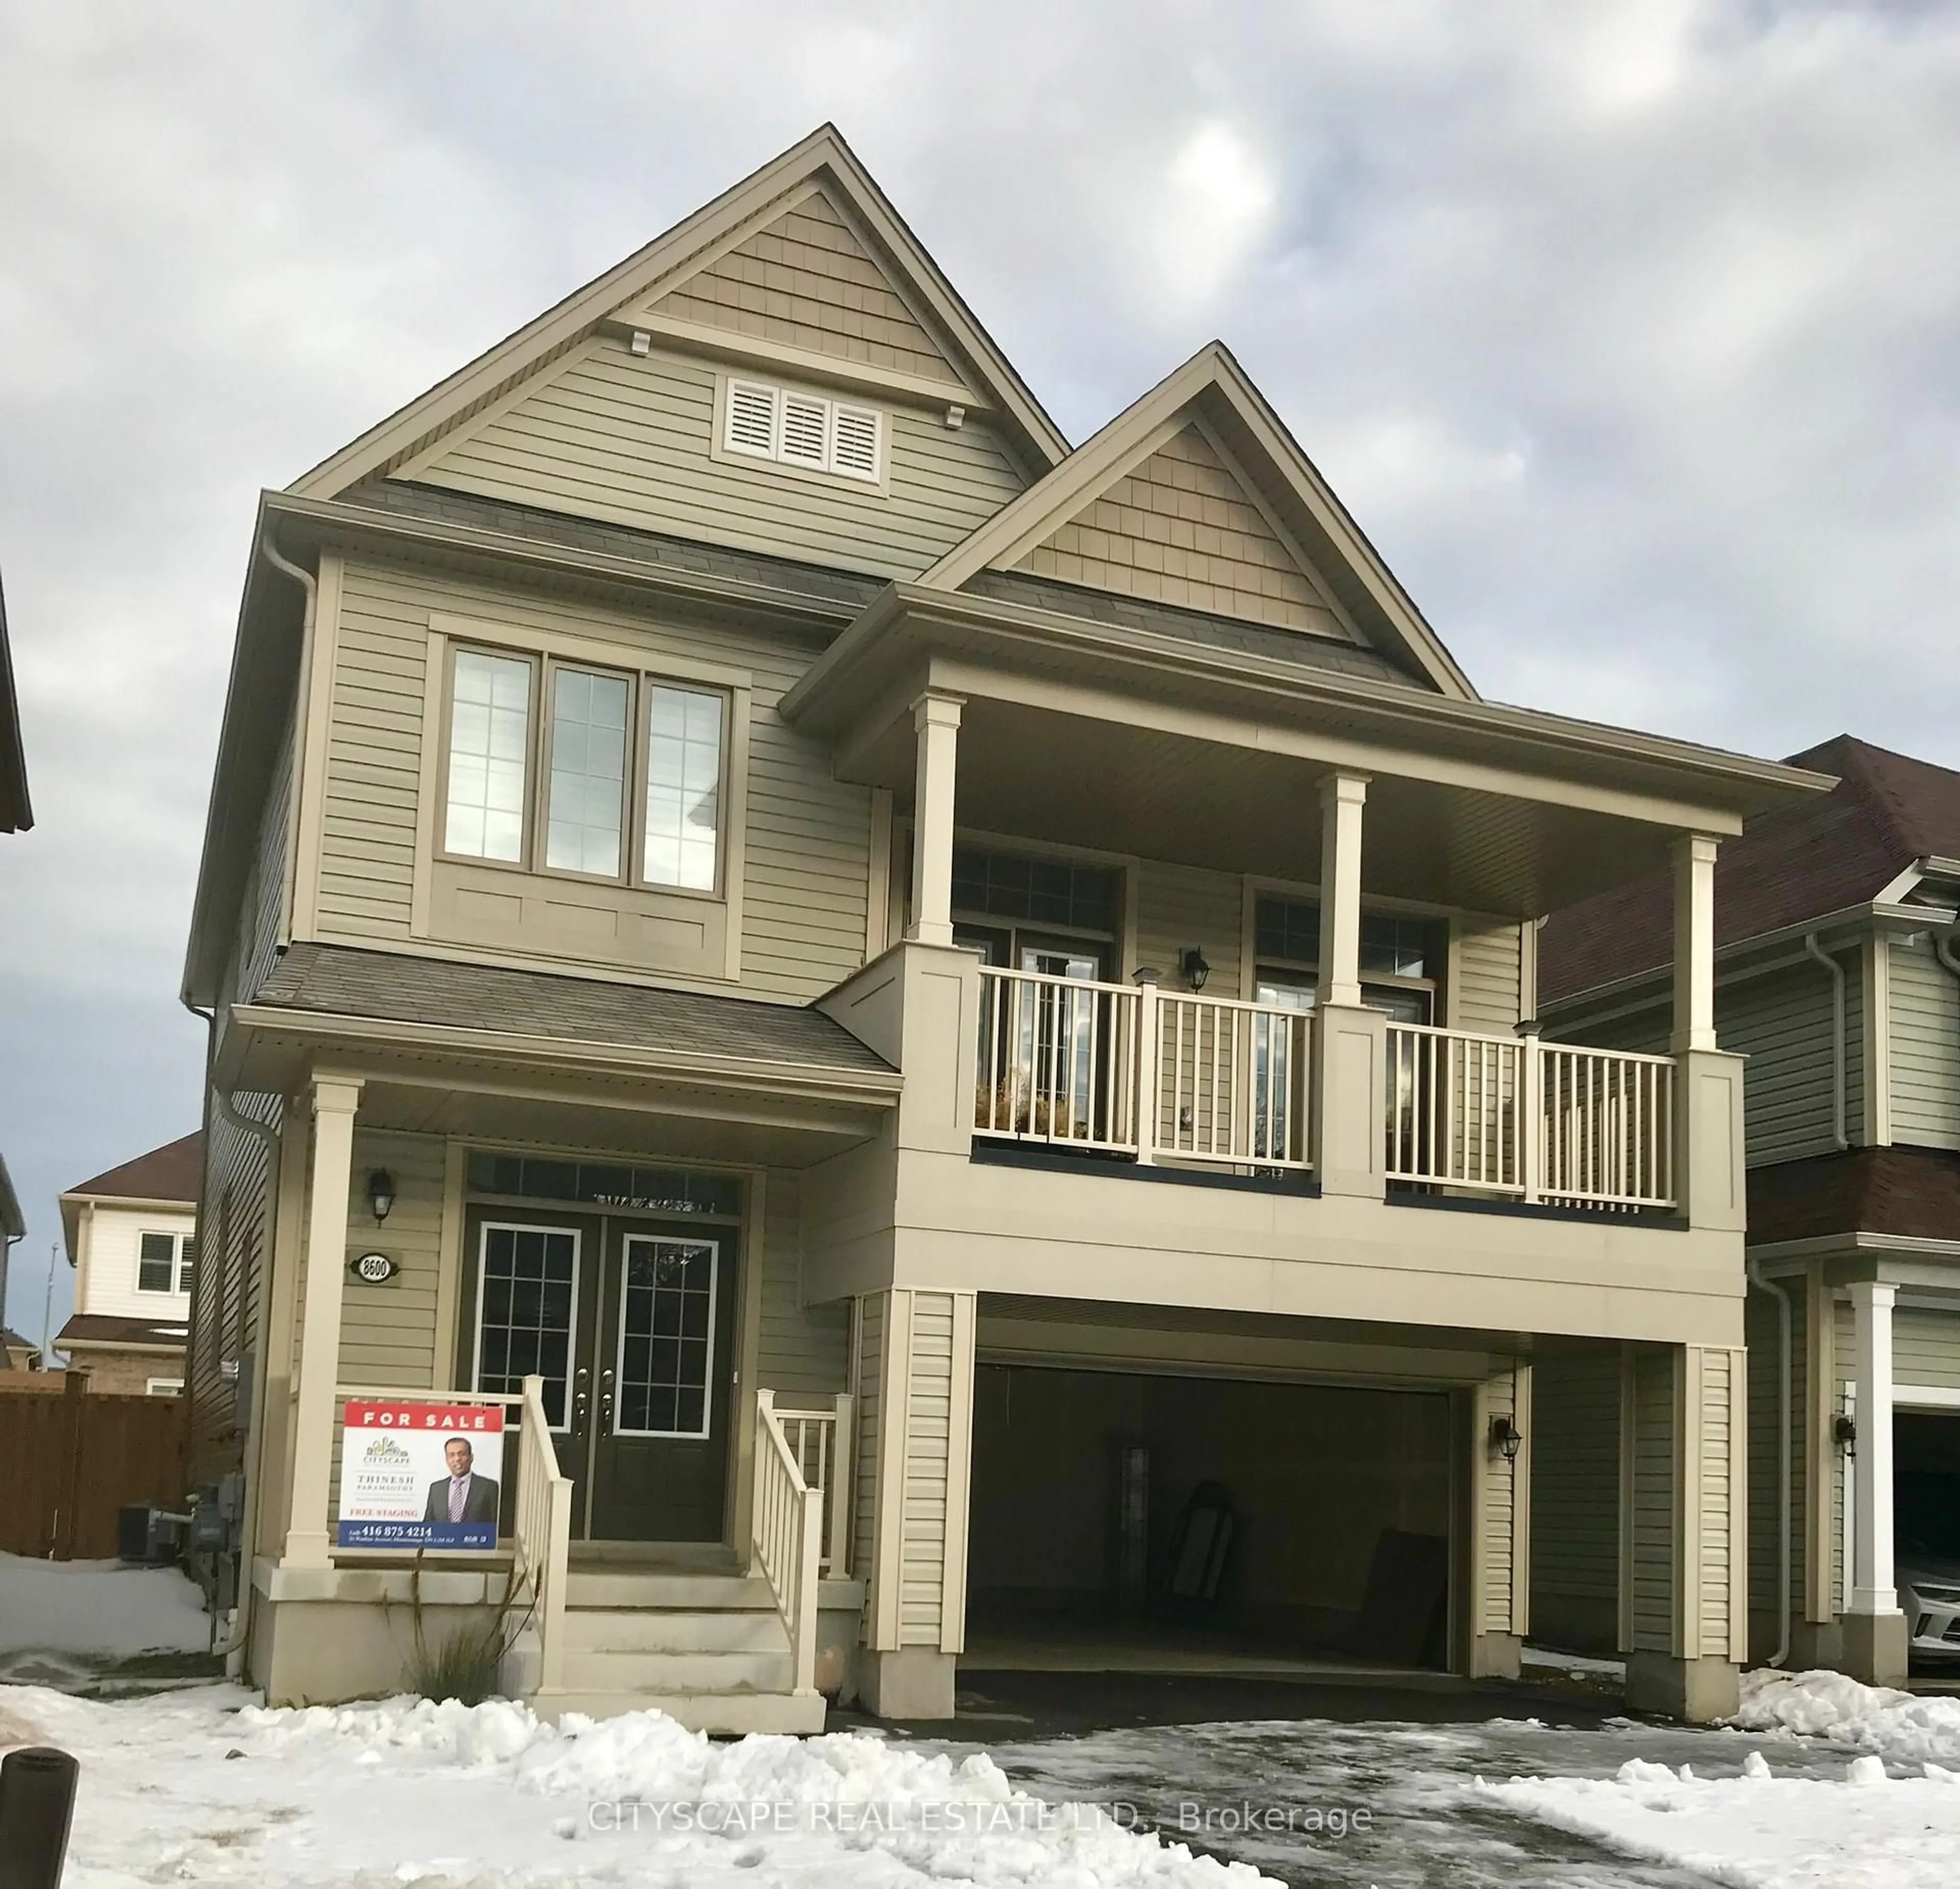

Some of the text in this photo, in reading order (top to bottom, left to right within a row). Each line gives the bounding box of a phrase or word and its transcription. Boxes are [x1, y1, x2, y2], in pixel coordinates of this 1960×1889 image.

[364, 1260, 386, 1276] 8600
[363, 1412, 485, 1428] FOR SALE
[358, 1475, 414, 1484] THINESH
[350, 1508, 418, 1517] FREE STAGING
[362, 1525, 382, 1536] 416
[384, 1526, 404, 1537] 875
[406, 1527, 432, 1537] 4214
